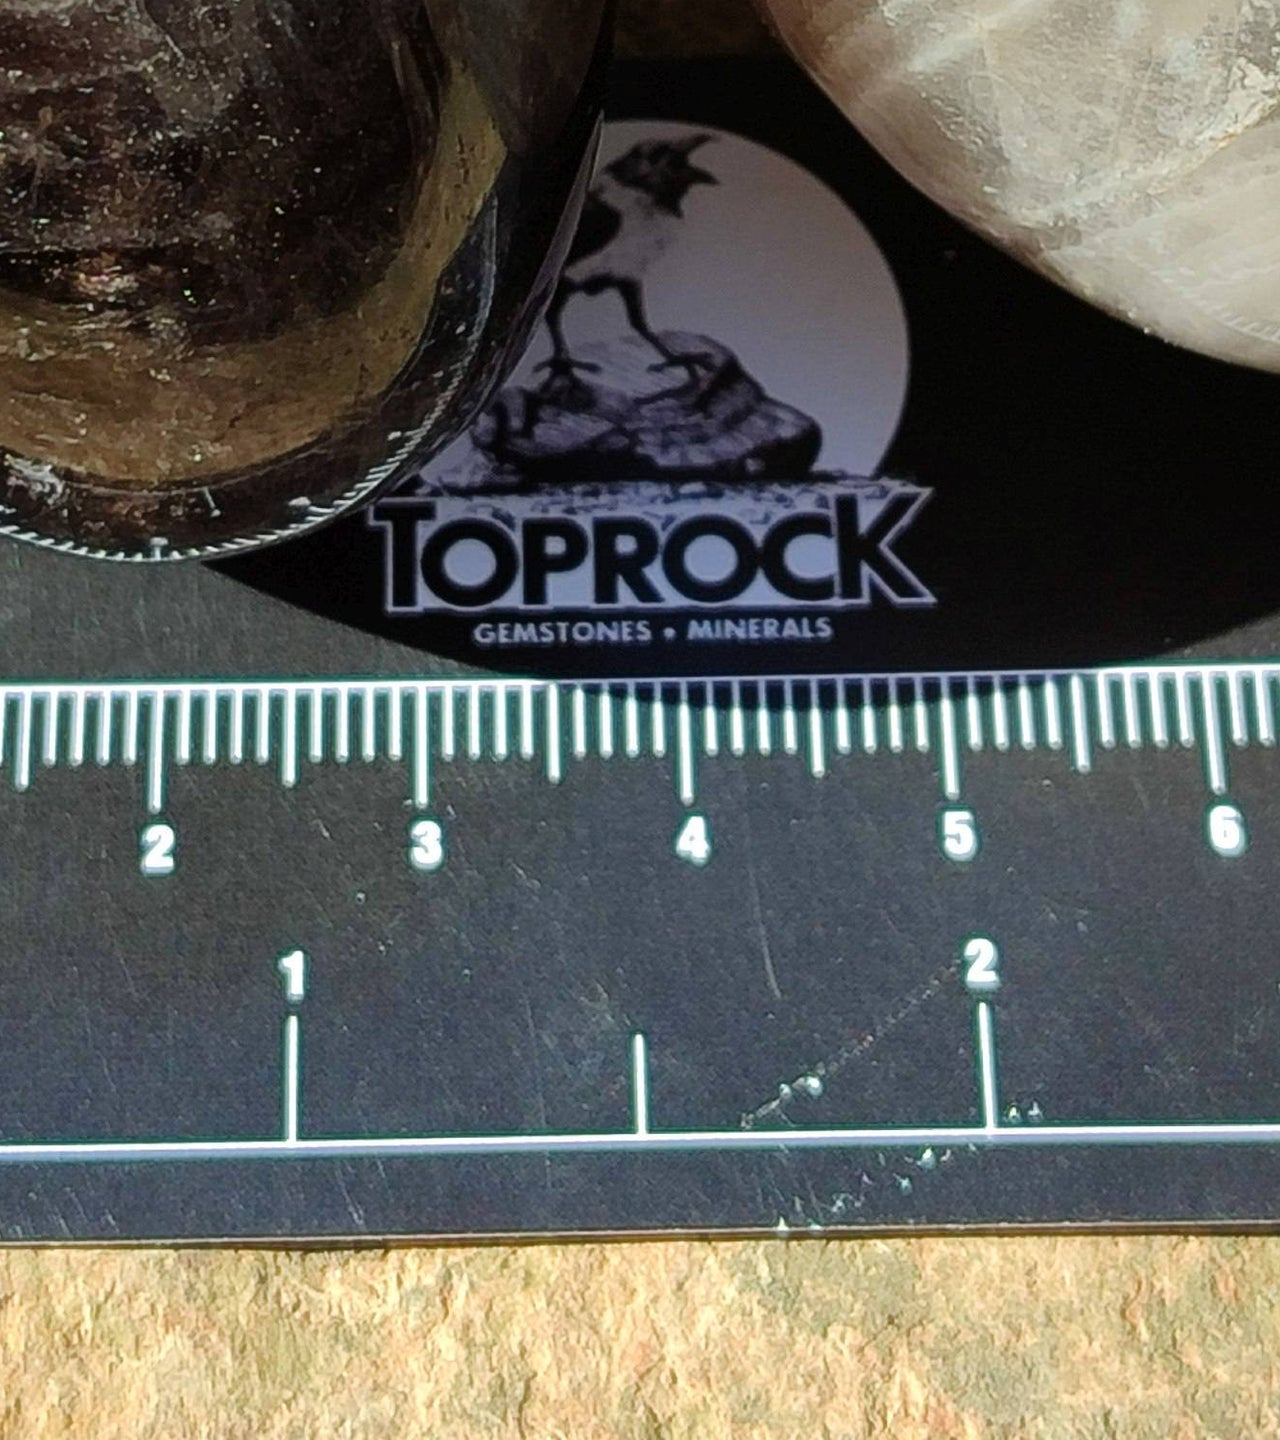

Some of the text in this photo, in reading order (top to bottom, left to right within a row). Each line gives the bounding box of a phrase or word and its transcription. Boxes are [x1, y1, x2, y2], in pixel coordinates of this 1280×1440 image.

[370, 488, 936, 614] TOPROCK
[472, 615, 833, 645] GEMSTONES MINERALS
[140, 824, 175, 874] 2
[410, 820, 444, 870] 3
[675, 815, 711, 865] 4
[942, 810, 978, 862] 5
[1208, 804, 1246, 857] 6
[278, 950, 305, 1002] 1
[963, 937, 1000, 991] 2
